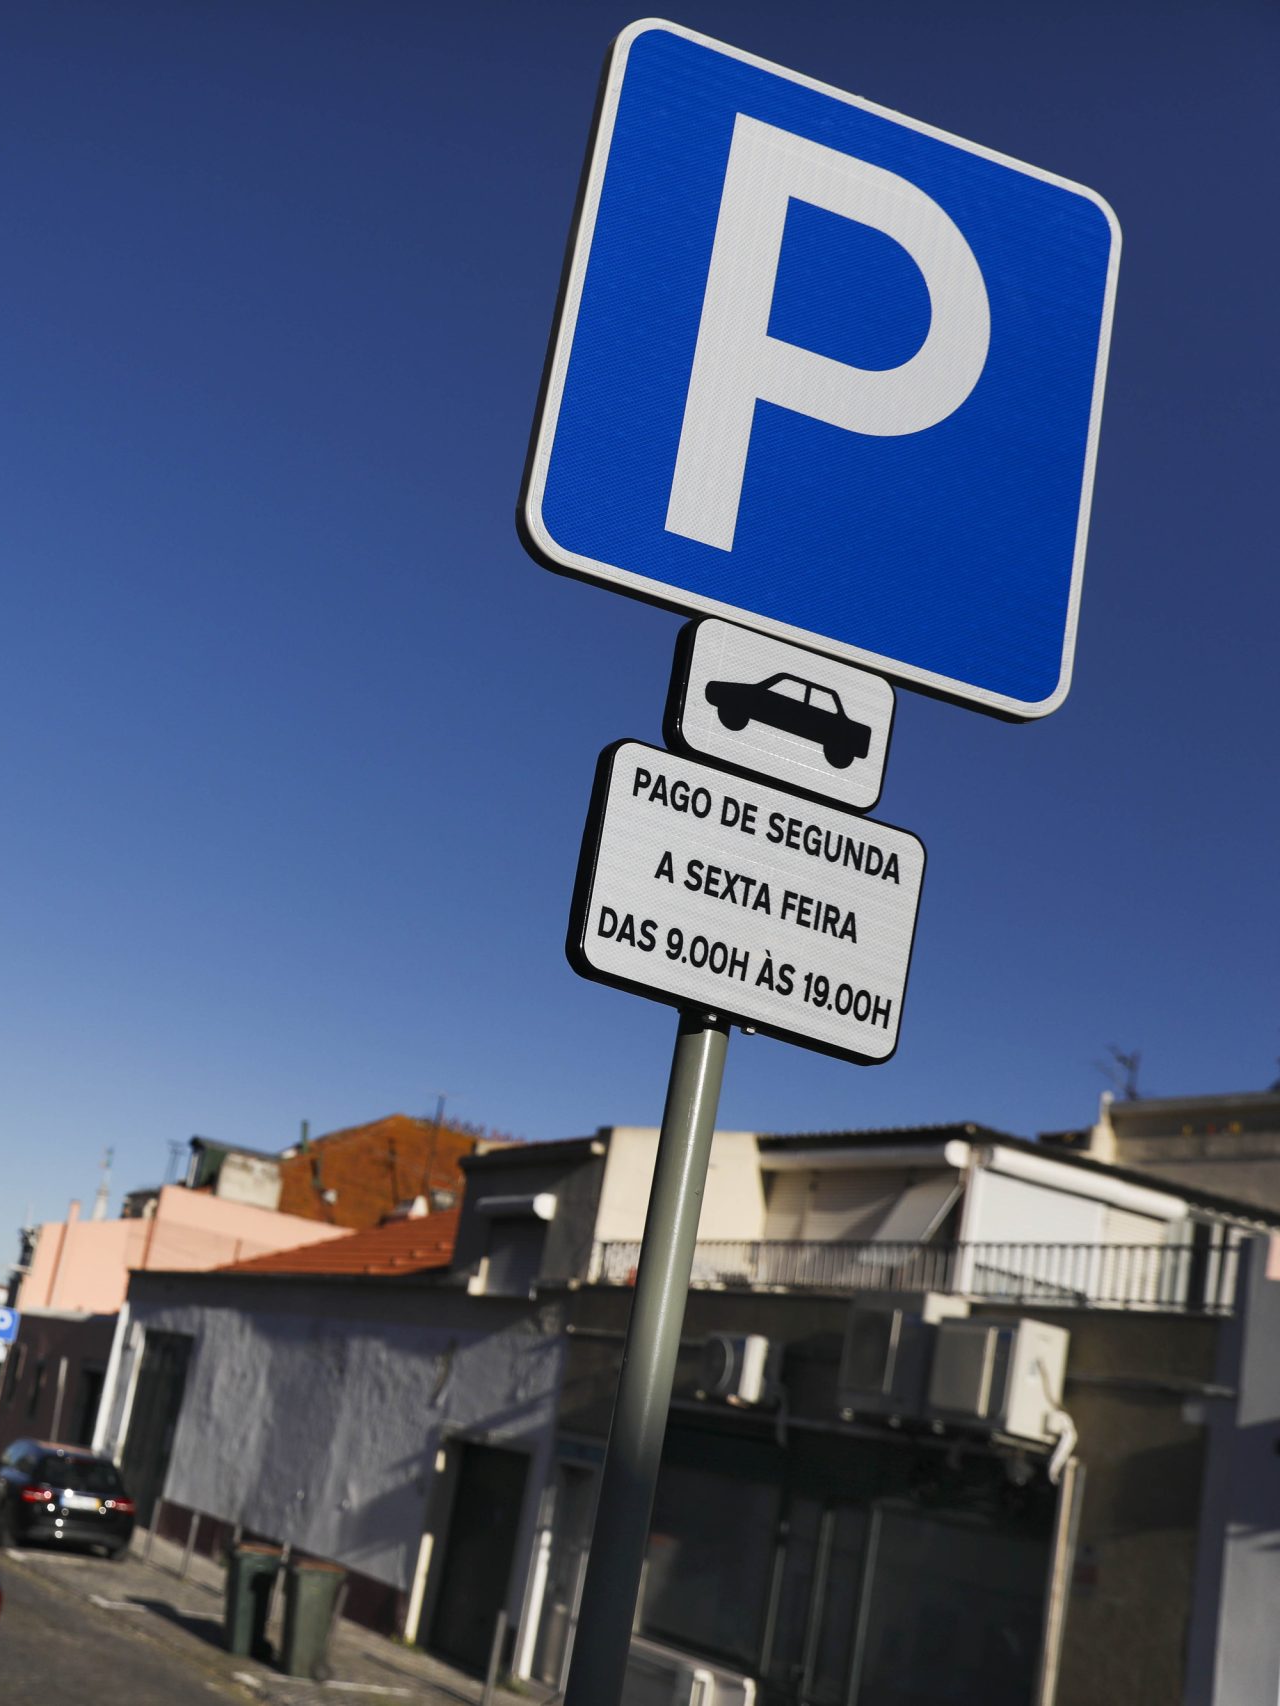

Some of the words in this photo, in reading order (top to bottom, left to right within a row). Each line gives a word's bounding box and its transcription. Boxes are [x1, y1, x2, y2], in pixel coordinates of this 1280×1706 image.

[664, 111, 991, 552] P
[632, 766, 712, 819] PAGO
[720, 795, 759, 836] DE
[765, 812, 900, 885] SEGUNDA
[653, 850, 674, 884] A
[683, 859, 771, 916] SEXTA
[780, 889, 857, 944] FEIRA
[597, 905, 659, 953] DAS
[665, 927, 750, 982] 9.00H
[754, 949, 796, 996] ÀS
[803, 971, 892, 1030] 19.00H
